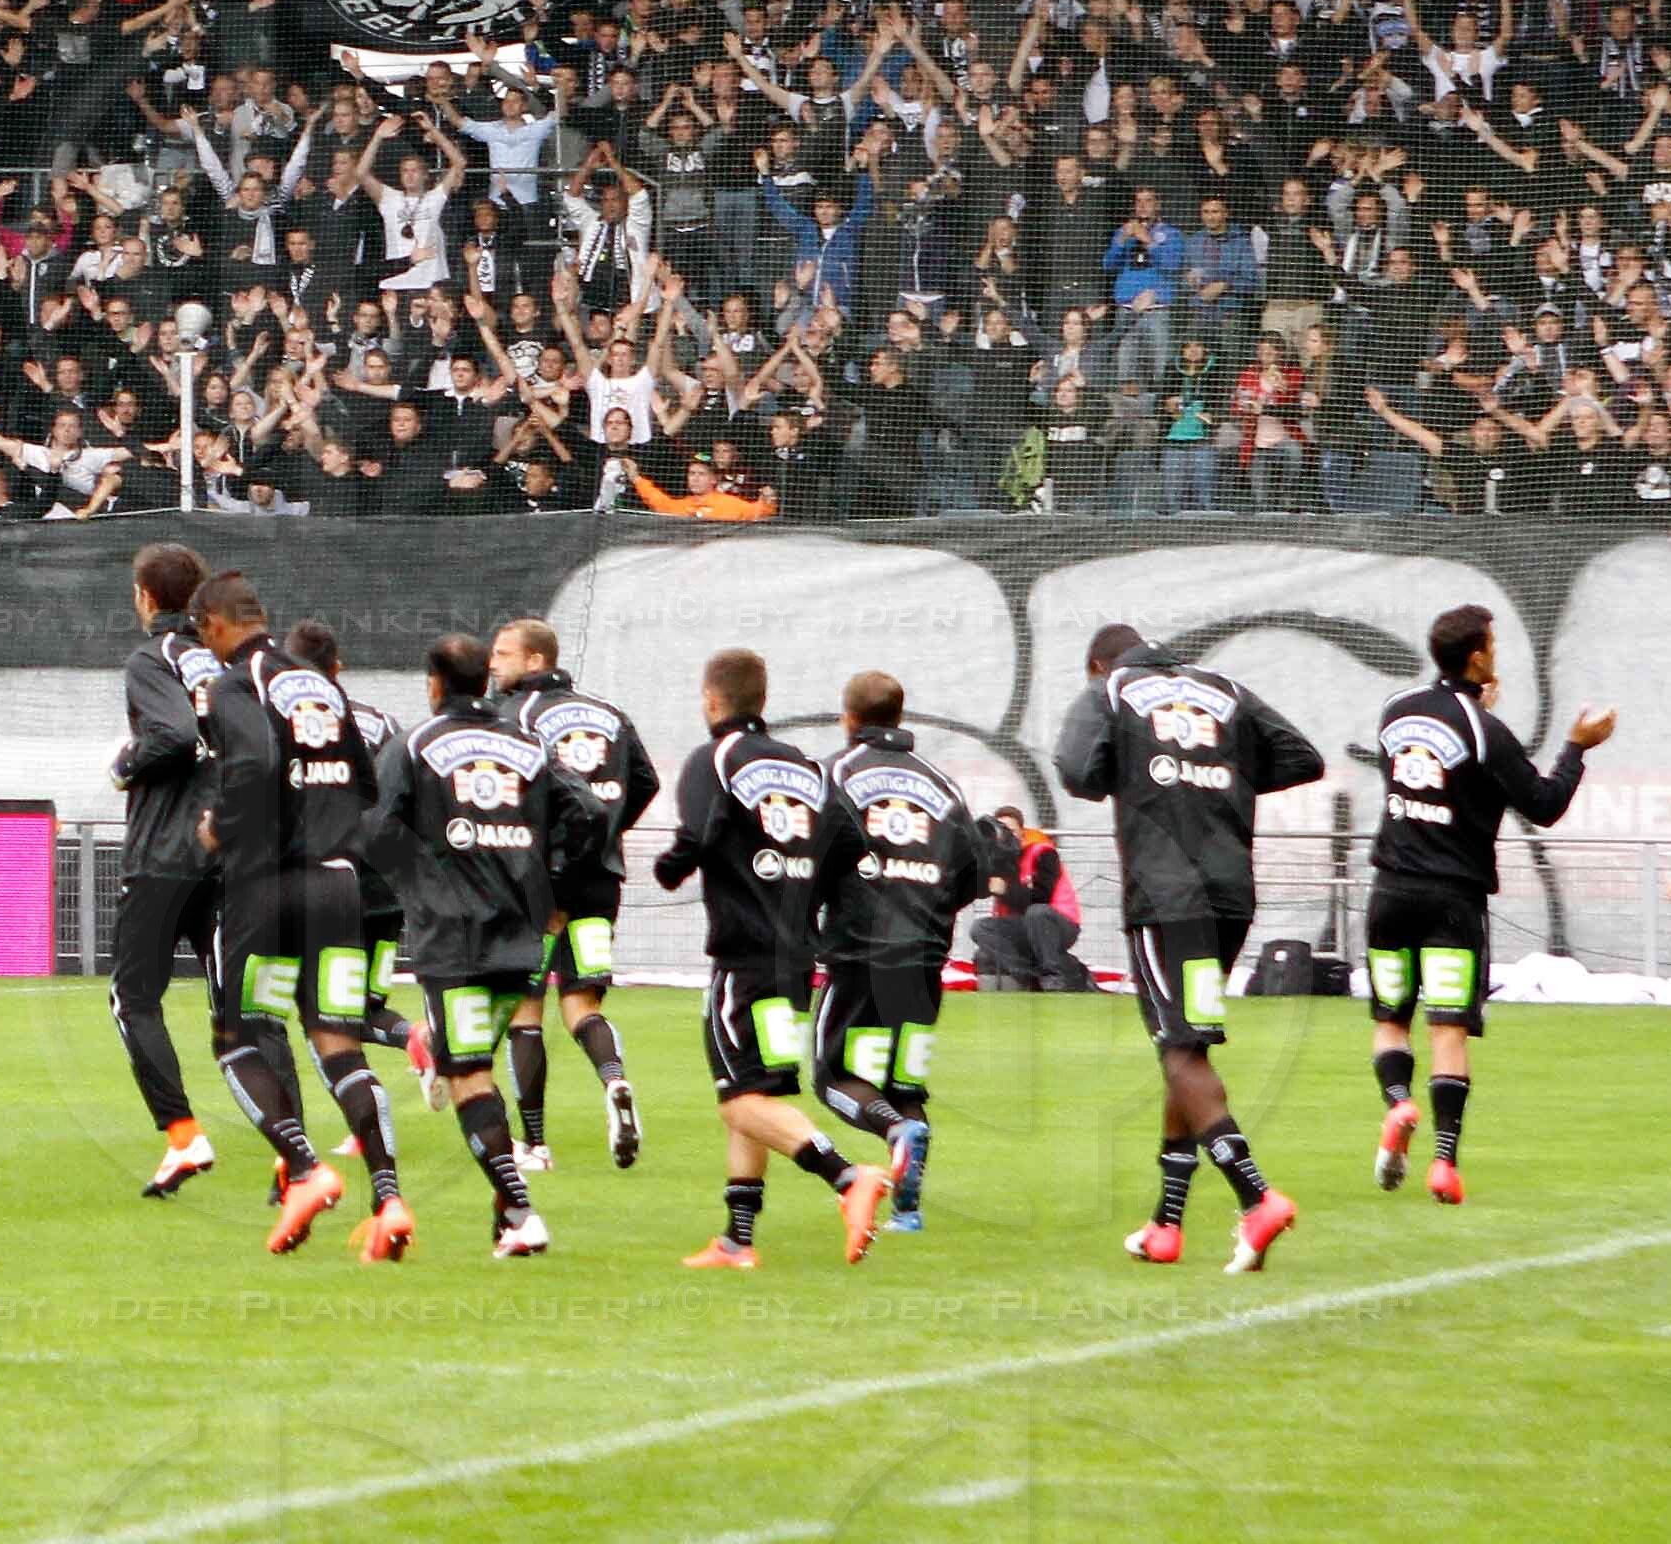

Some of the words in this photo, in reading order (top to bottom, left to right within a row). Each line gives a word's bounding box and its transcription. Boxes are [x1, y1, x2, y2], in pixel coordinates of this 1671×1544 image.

[304, 760, 351, 784] JAKO
[735, 766, 821, 800] PUNTIGAMER
[476, 823, 534, 848] JAKO
[882, 858, 942, 884] JAKO
[577, 923, 612, 967] E
[255, 964, 299, 1011] E
[327, 956, 367, 1007] E
[1425, 955, 1465, 999] E
[456, 994, 493, 1044] E
[854, 1035, 892, 1084] E
